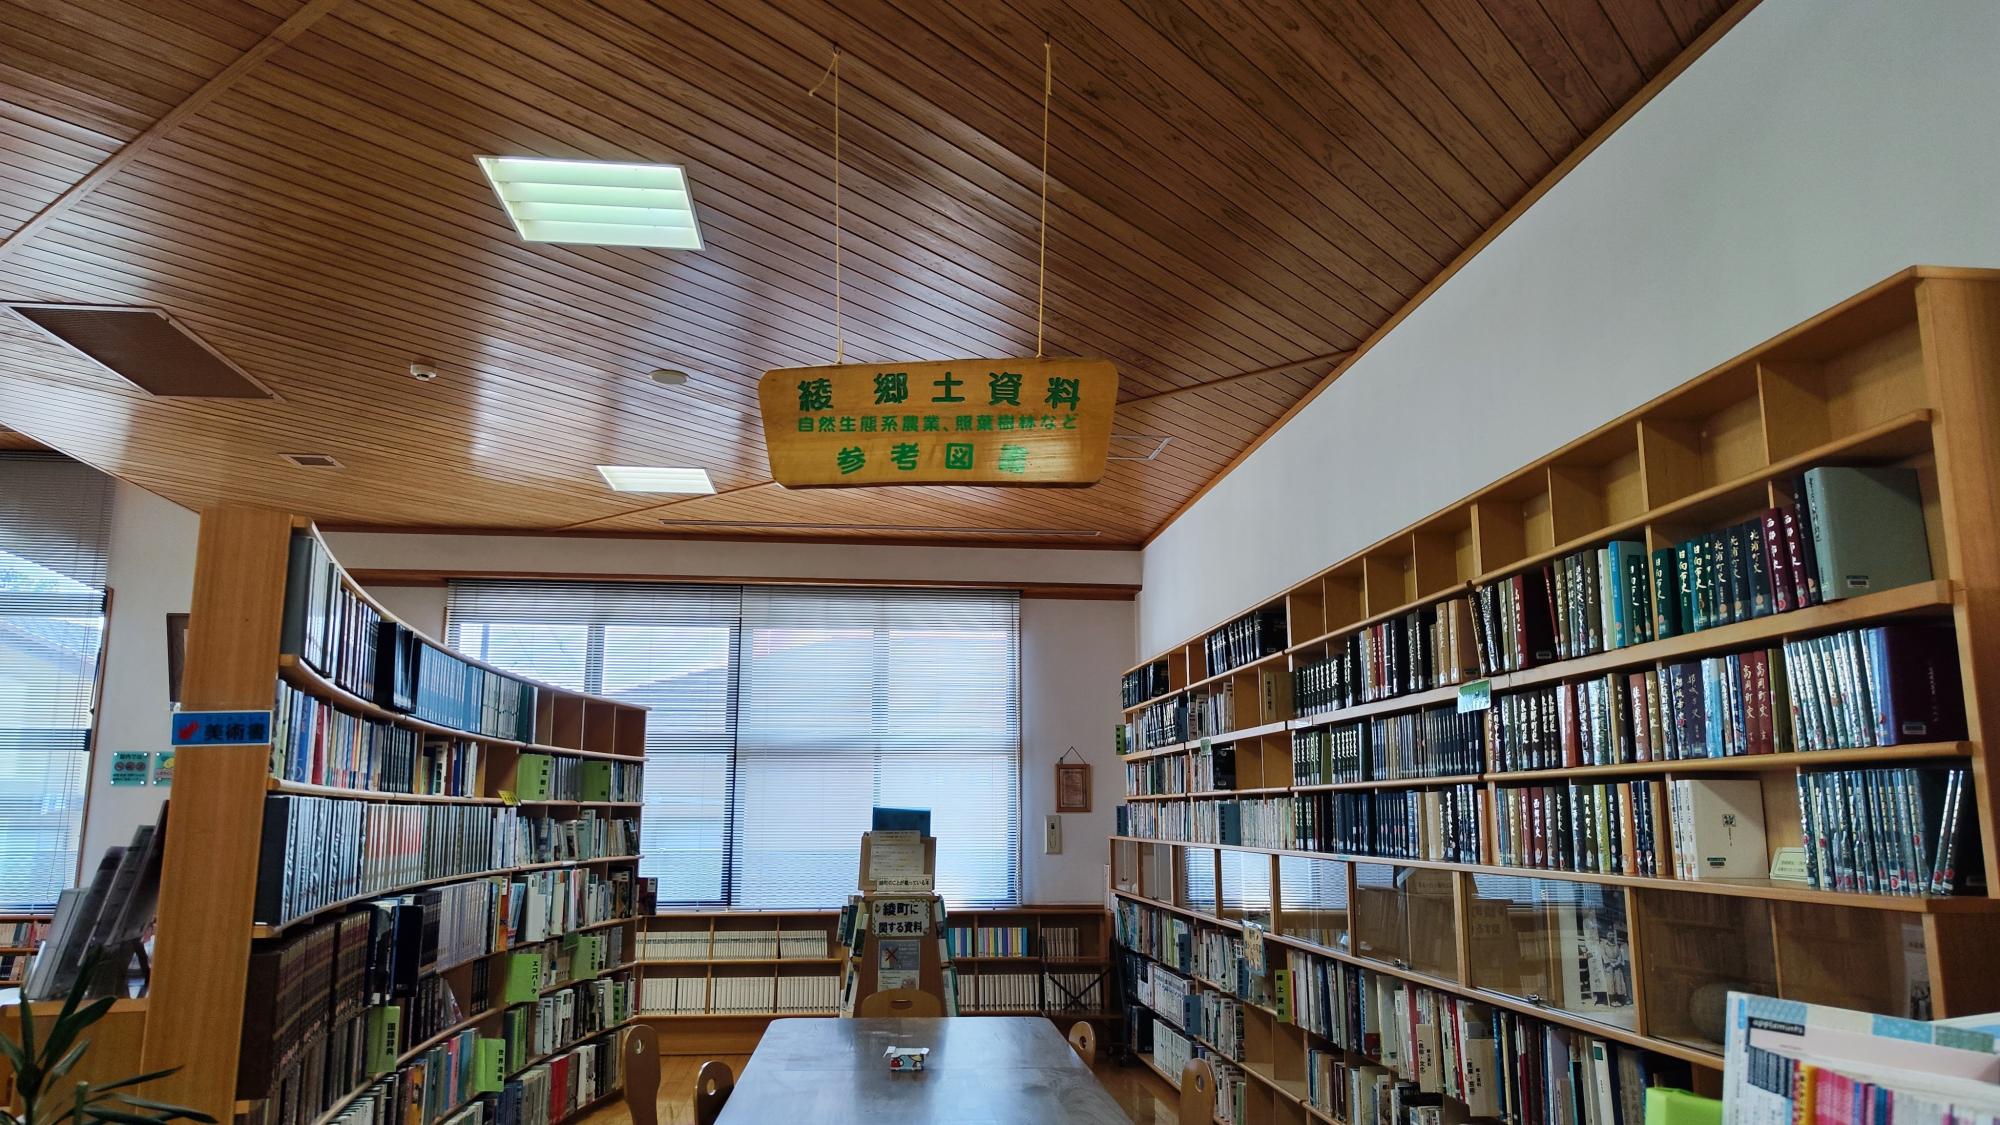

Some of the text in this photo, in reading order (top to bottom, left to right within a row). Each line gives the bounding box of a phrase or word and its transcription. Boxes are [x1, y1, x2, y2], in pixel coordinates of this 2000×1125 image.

[797, 371, 1081, 412] 綾 郷土資料
[798, 413, 1078, 433] 自然生態系農業、照葉樹林など
[837, 442, 1030, 475] 参考図書
[1743, 664, 1755, 719] 高岡町史
[1756, 661, 1768, 717] 高岡町史
[882, 903, 918, 917] 綾町に
[878, 921, 922, 933] 関する資料
